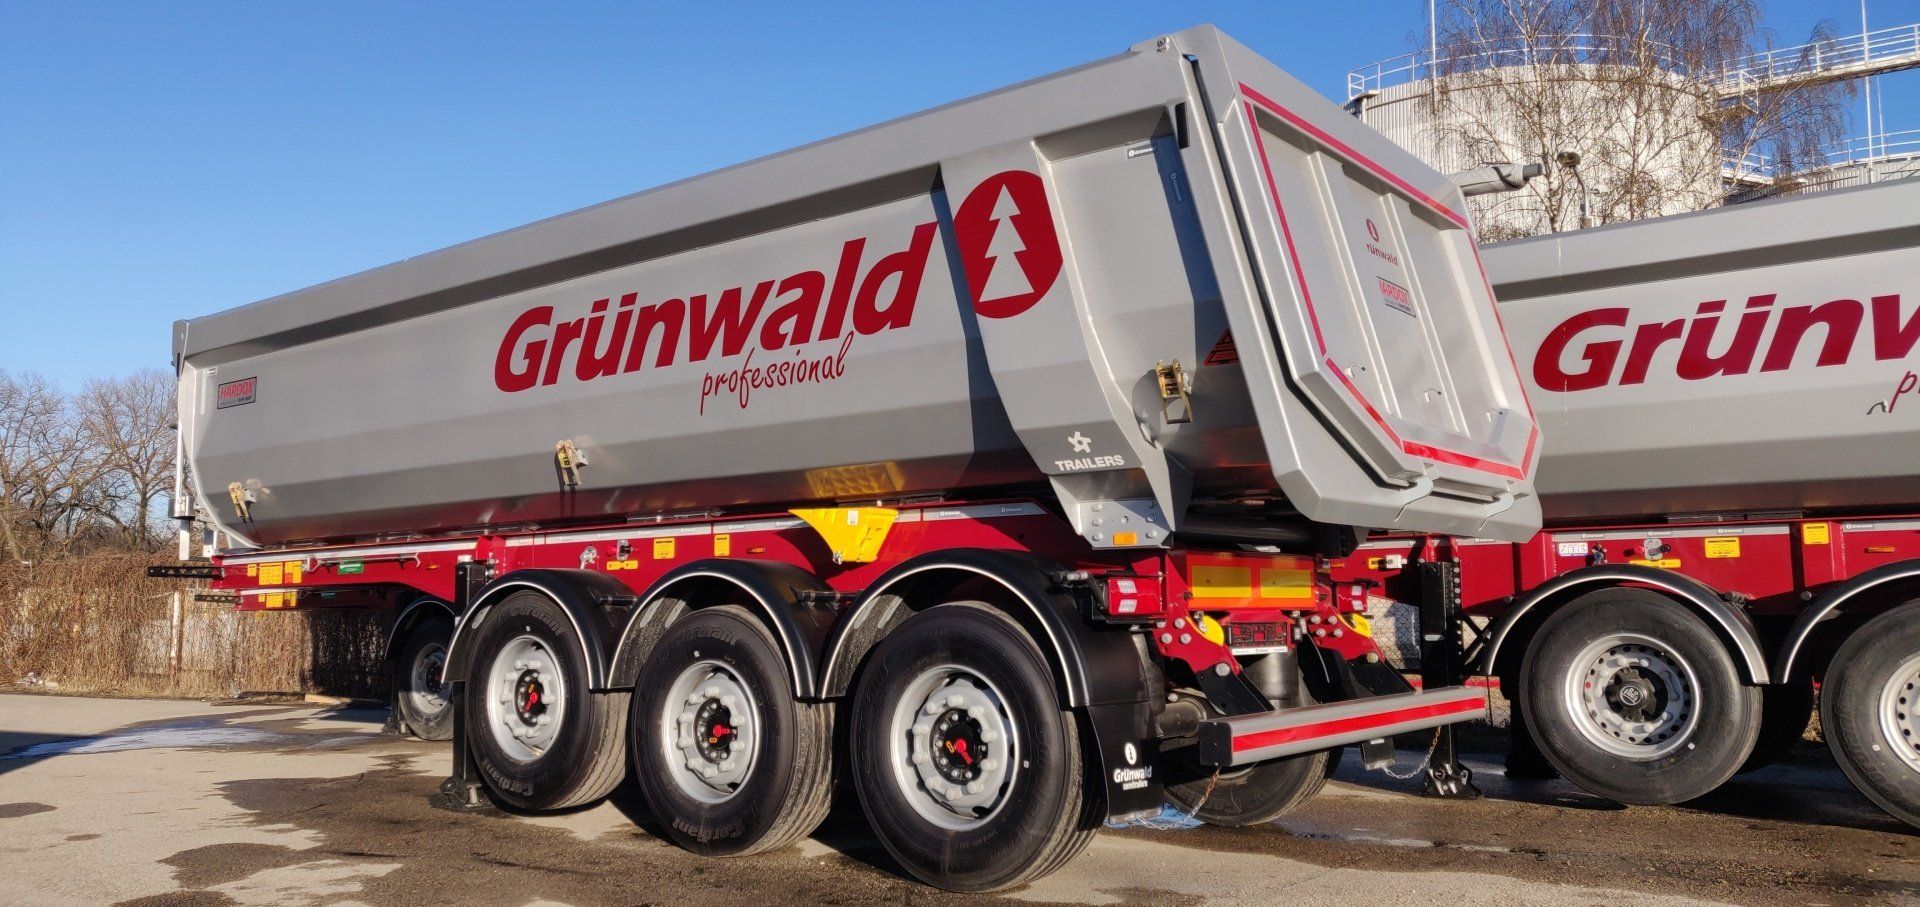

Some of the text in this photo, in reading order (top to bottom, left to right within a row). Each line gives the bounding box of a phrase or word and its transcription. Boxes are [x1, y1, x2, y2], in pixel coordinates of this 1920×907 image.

[494, 222, 938, 393] Grünwald
[700, 331, 855, 416] professional
[1055, 455, 1125, 471] TRAILERS
[1113, 765, 1153, 783] Grünwald
